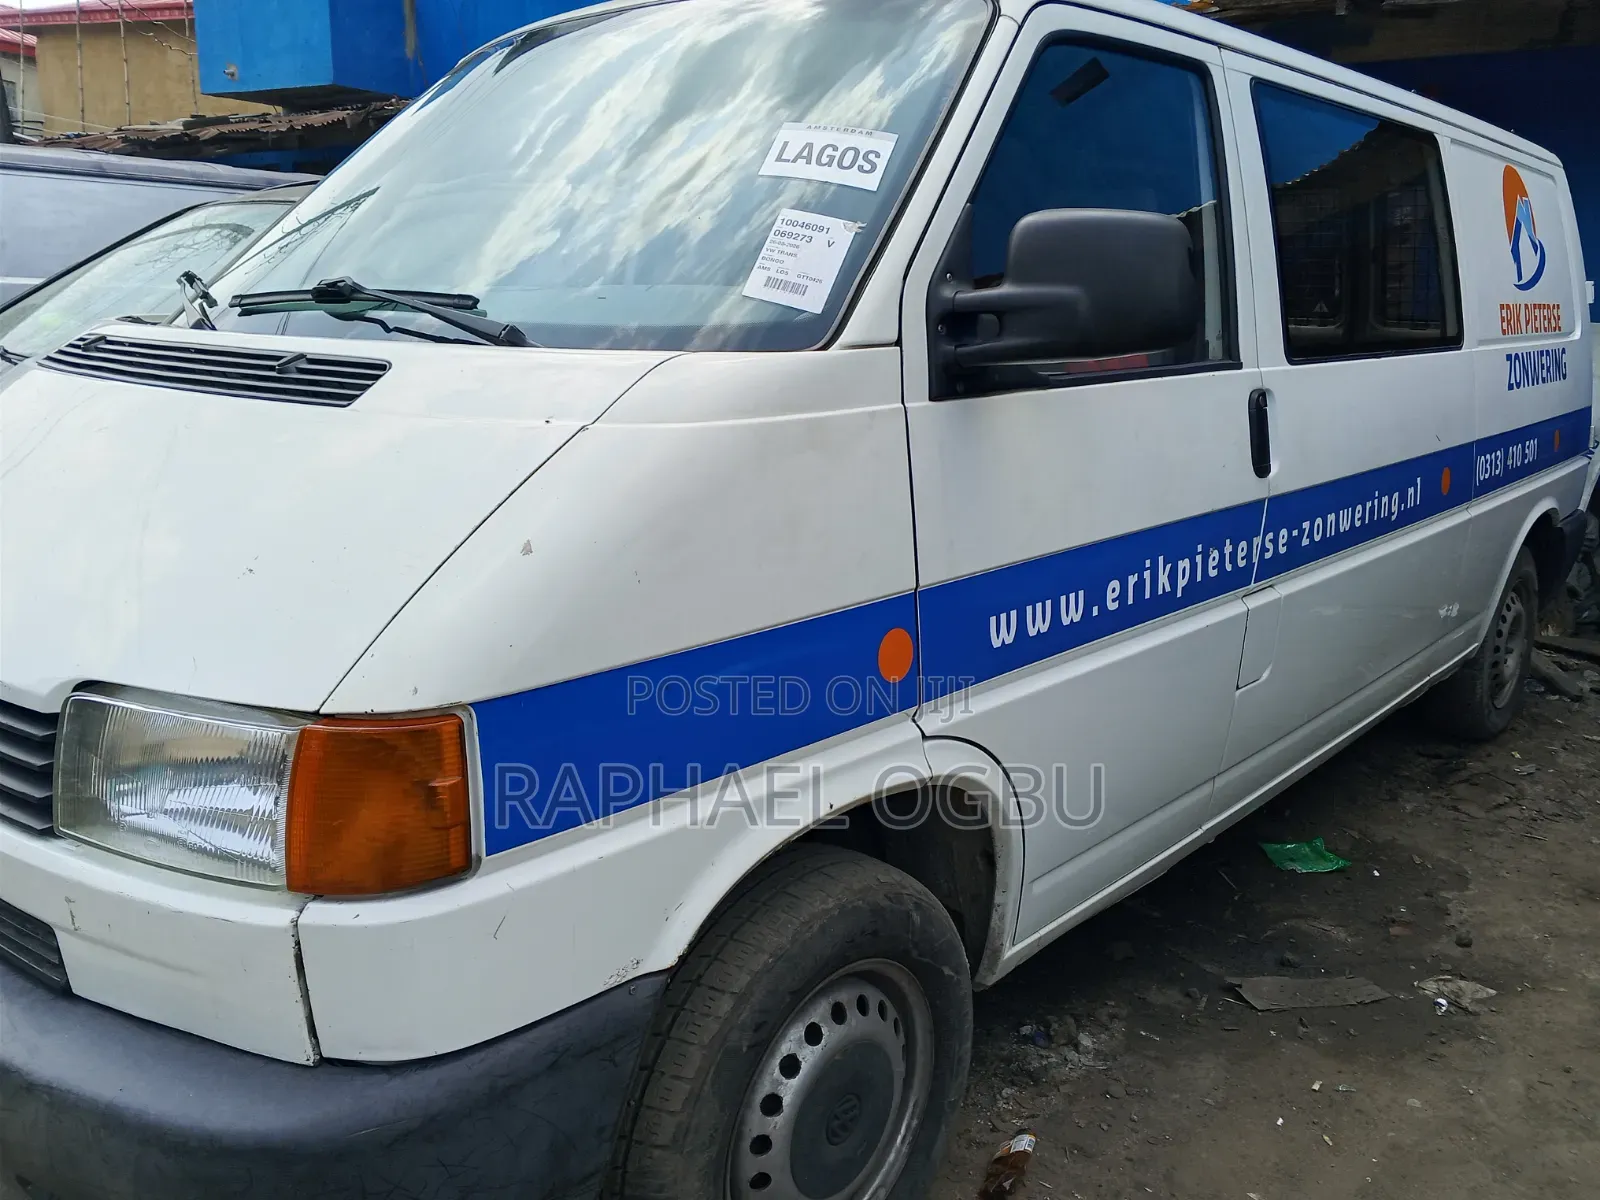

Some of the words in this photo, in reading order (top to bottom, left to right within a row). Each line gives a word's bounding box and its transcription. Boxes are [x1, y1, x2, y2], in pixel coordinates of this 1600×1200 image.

[806, 124, 873, 136] AMSTERDAM
[774, 140, 881, 174] LAGOS
[773, 229, 813, 243] 069273
[827, 240, 835, 248] V
[780, 217, 830, 235] 10046091
[1499, 303, 1523, 336] ERIK
[1525, 303, 1561, 334] PIETERSE
[1506, 347, 1567, 391] ZONWERING
[1476, 447, 1504, 486] (0313)
[1507, 443, 1523, 470] 410
[1524, 437, 1538, 463] 501
[989, 477, 1422, 648] www.erikpieterse-zonwering.nl
